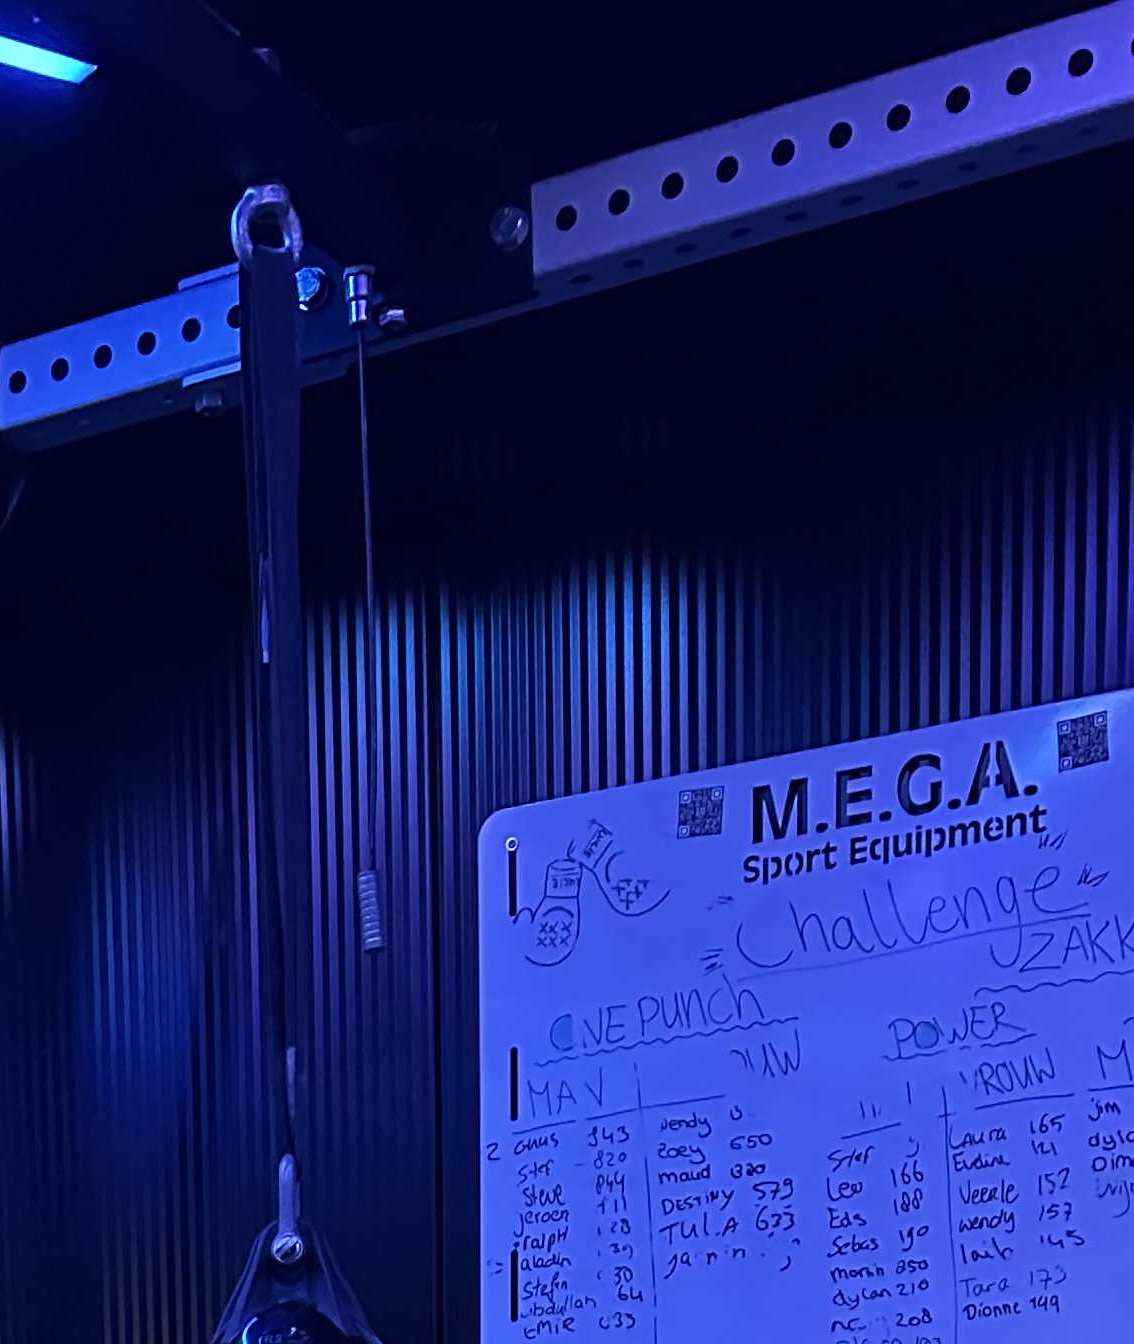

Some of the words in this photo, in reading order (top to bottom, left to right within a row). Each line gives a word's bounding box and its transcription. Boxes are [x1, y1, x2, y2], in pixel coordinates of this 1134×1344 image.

[751, 740, 1039, 845] M.E.G.A.
[743, 841, 838, 885] Sport
[850, 804, 1048, 866] Equipment
[736, 866, 1090, 968] Challenge
[888, 1001, 1027, 1059] POWER
[1030, 1113, 1066, 1134] 165
[730, 1133, 772, 1150] 650
[593, 1151, 627, 1169] 820
[891, 1159, 925, 1188] 166
[1038, 1167, 1071, 1196] 152
[752, 1177, 794, 1201] 579
[1038, 1202, 1072, 1222] 157
[899, 1225, 930, 1252] 190
[896, 1279, 929, 1296] 210
[896, 1307, 933, 1327] 208
